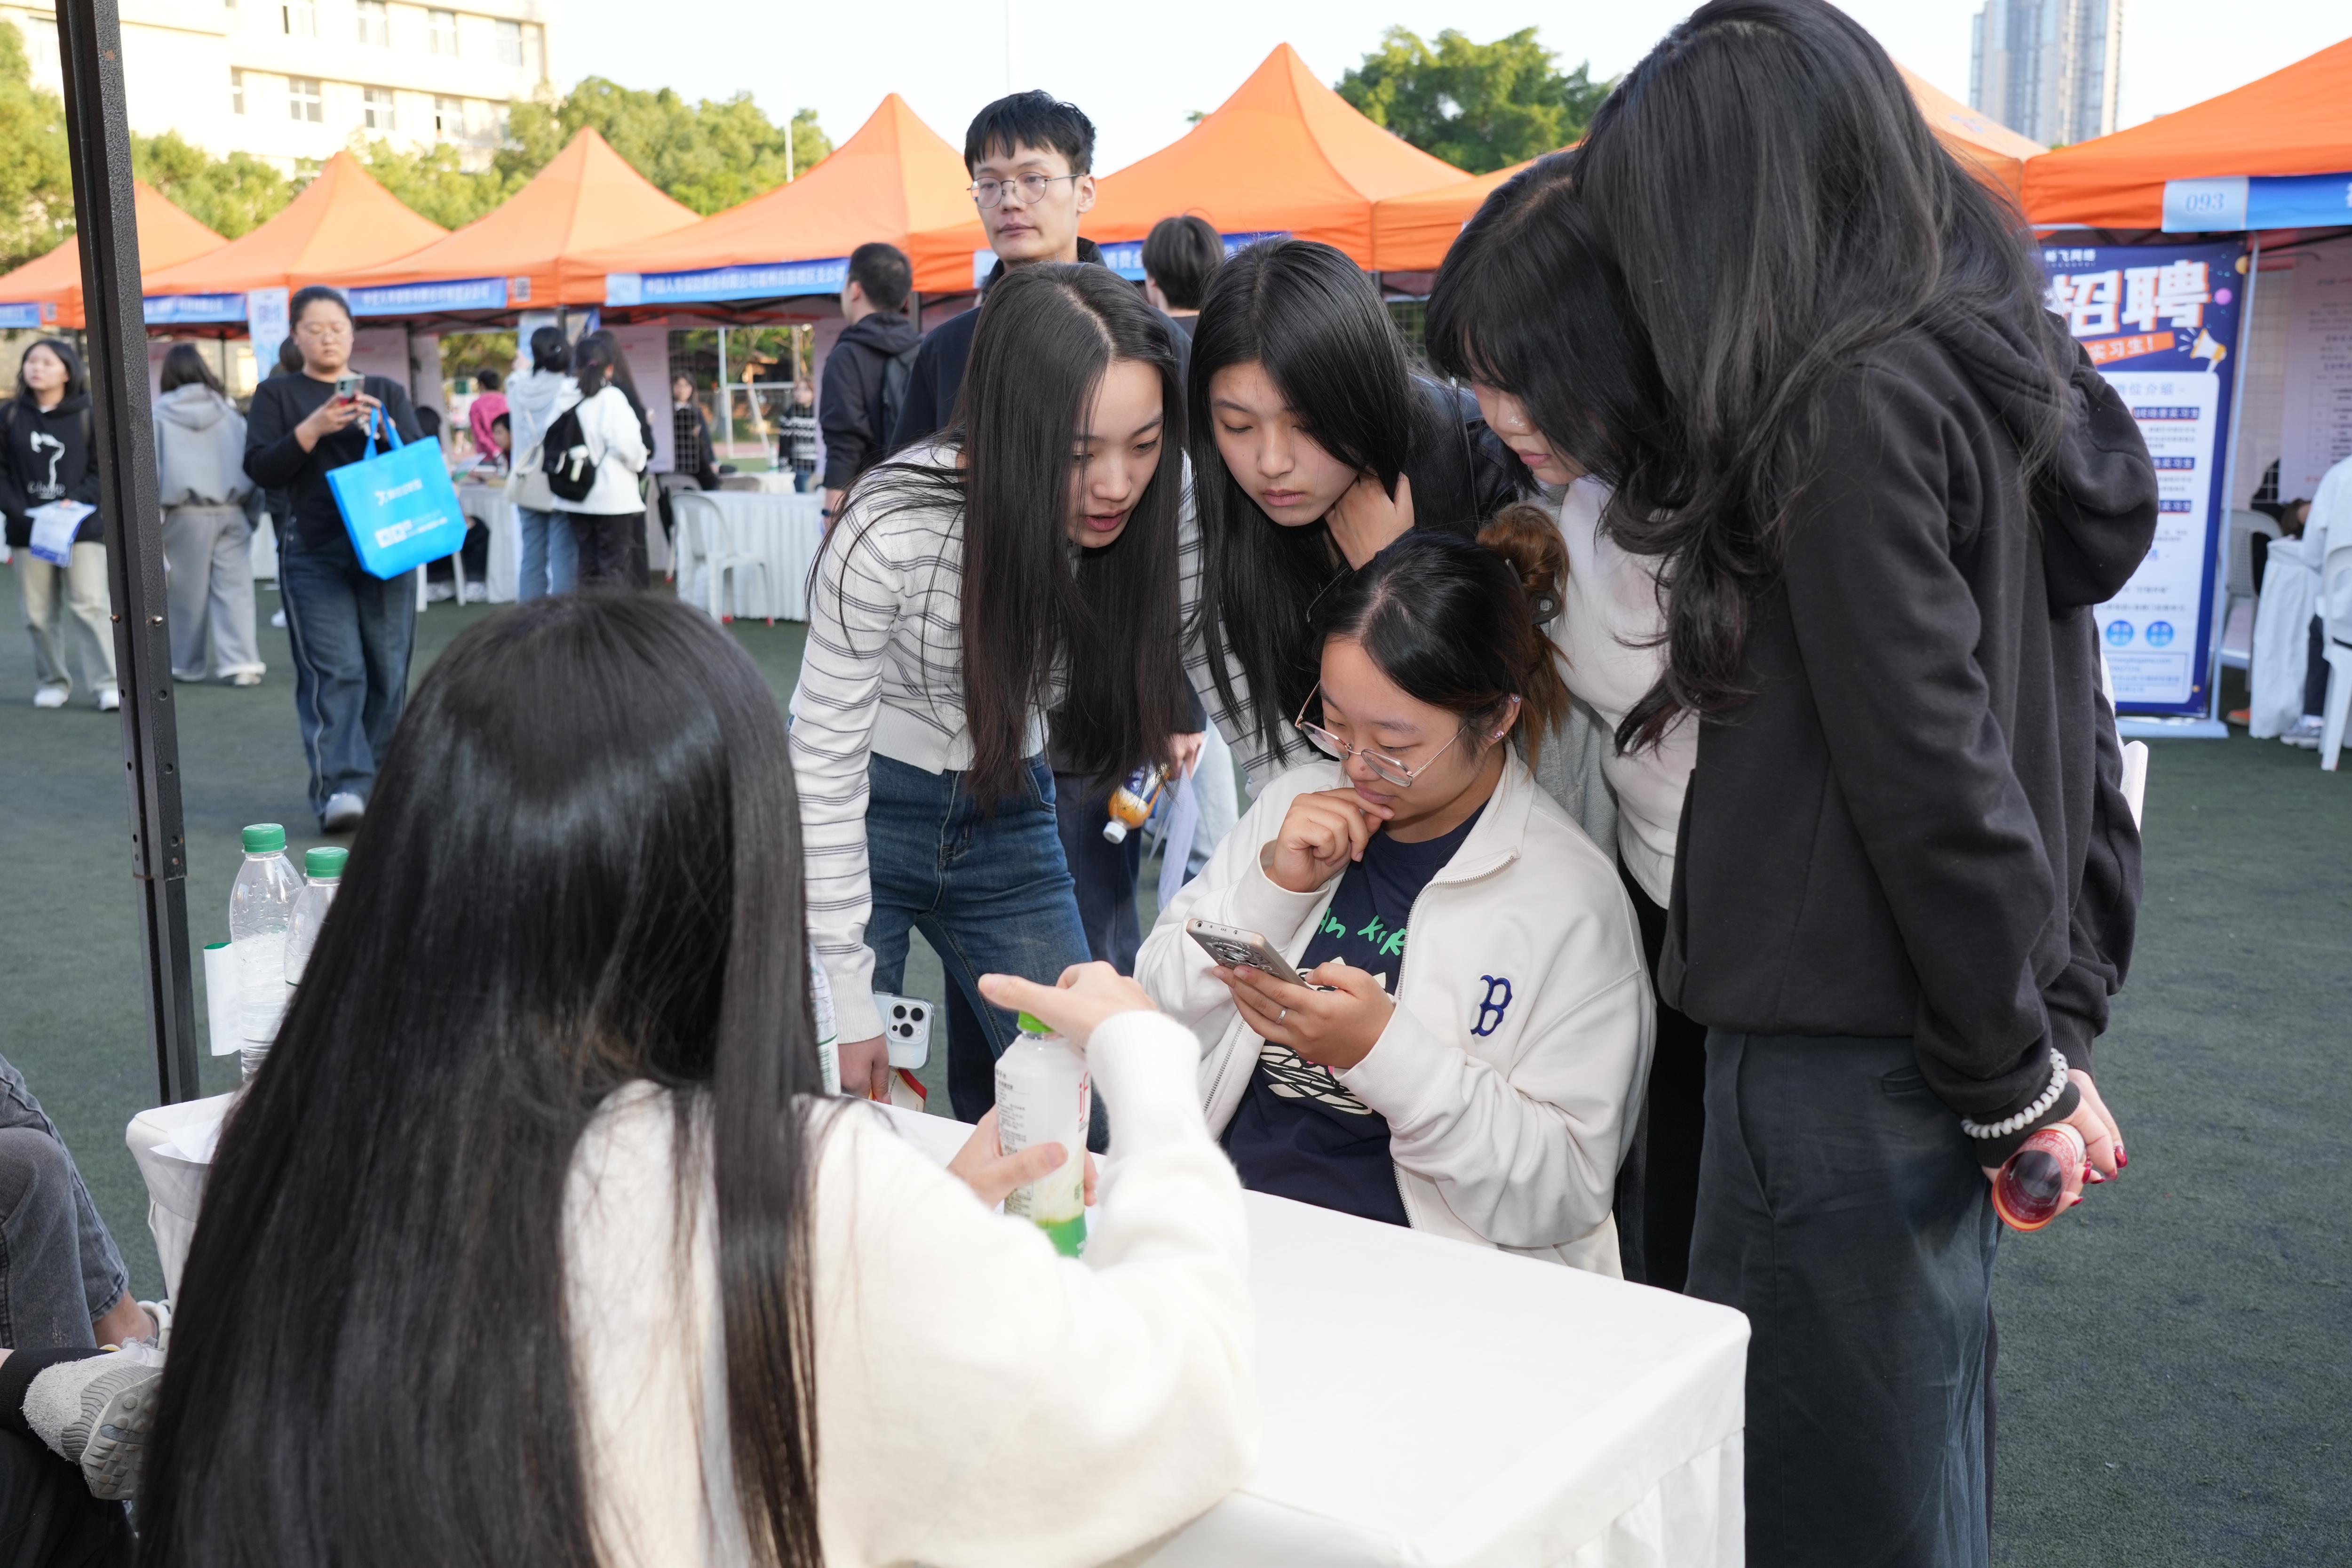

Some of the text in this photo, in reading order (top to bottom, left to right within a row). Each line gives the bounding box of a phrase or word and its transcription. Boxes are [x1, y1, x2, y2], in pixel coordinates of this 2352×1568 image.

[2185, 192, 2225, 212] 093
[2045, 259, 2211, 337] 招聘
[1470, 974, 1512, 1037] B
